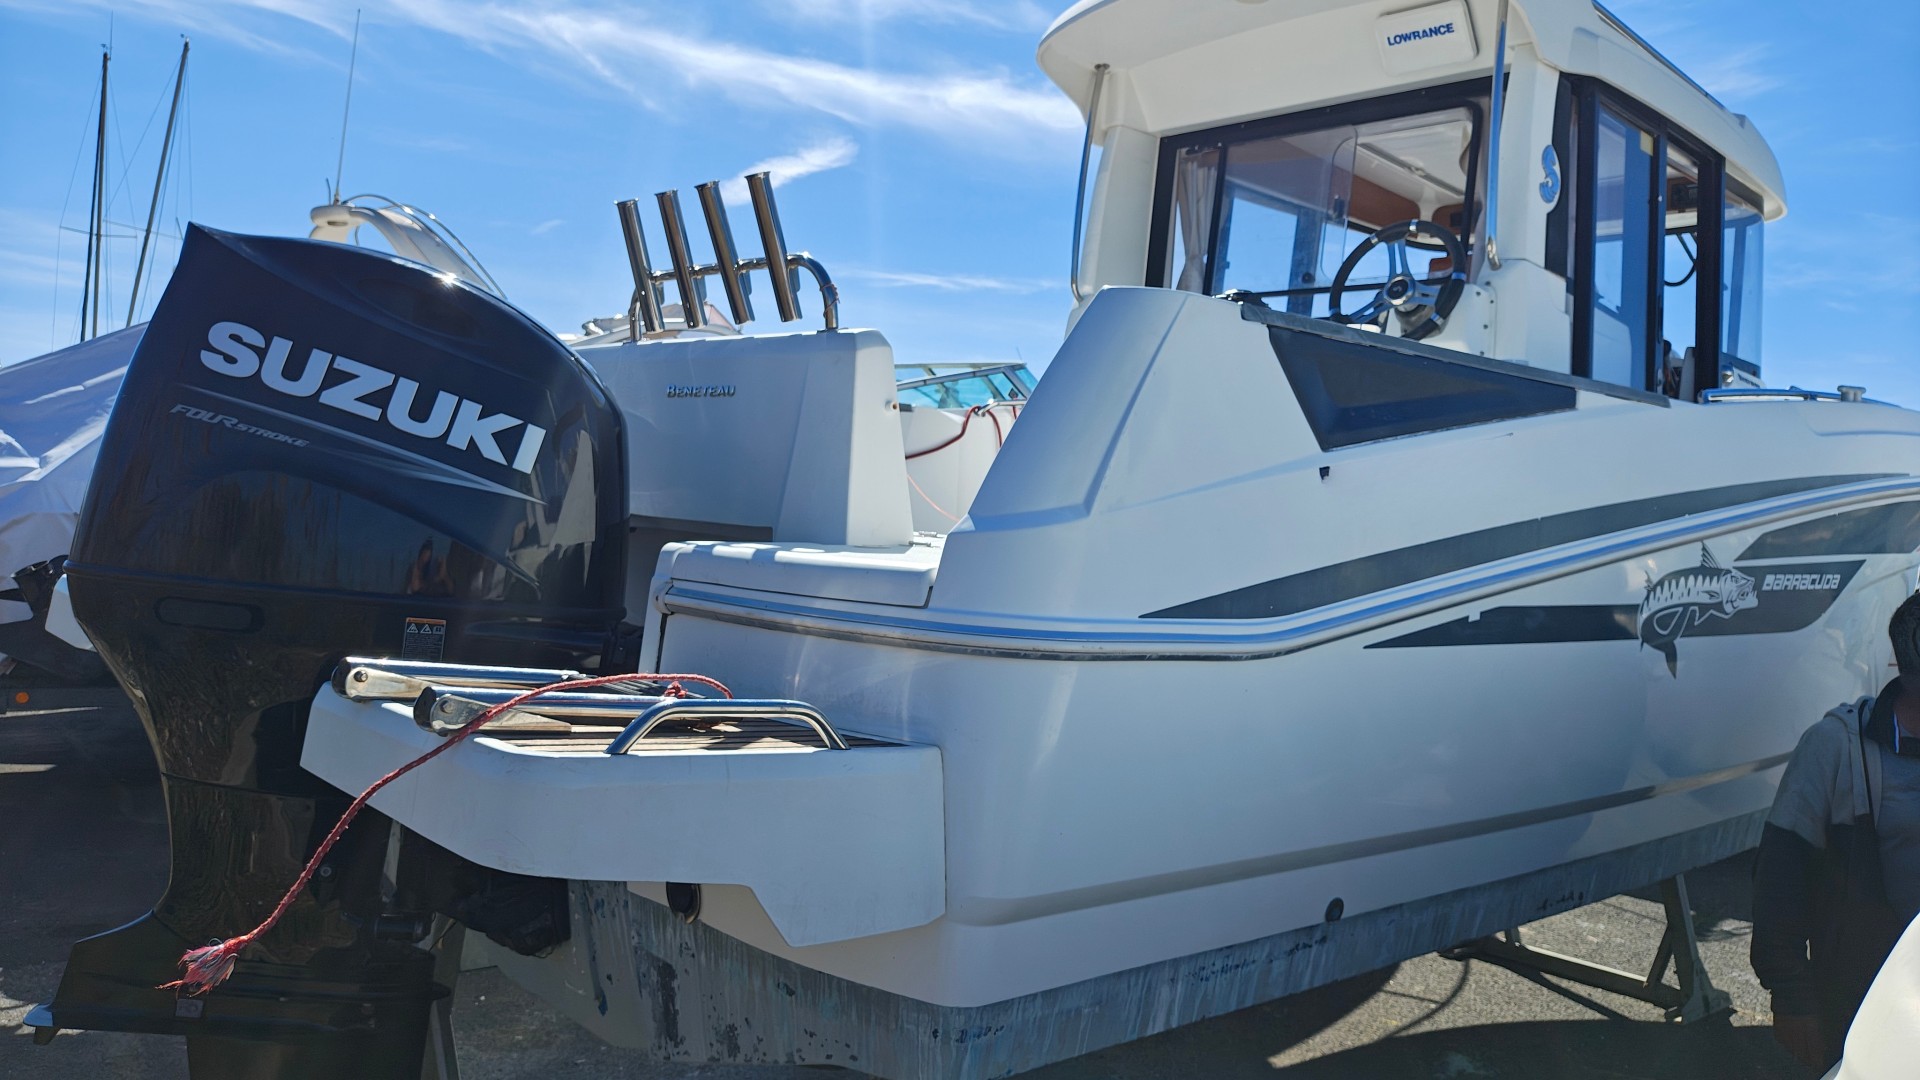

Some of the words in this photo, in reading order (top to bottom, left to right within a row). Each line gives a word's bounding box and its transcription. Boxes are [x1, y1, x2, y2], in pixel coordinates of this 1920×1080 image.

[1386, 22, 1455, 46] LOWRANCE
[199, 321, 546, 474] SUZUKI
[667, 384, 736, 398] BENETEAU
[1762, 574, 1841, 591] BARRACUDA
